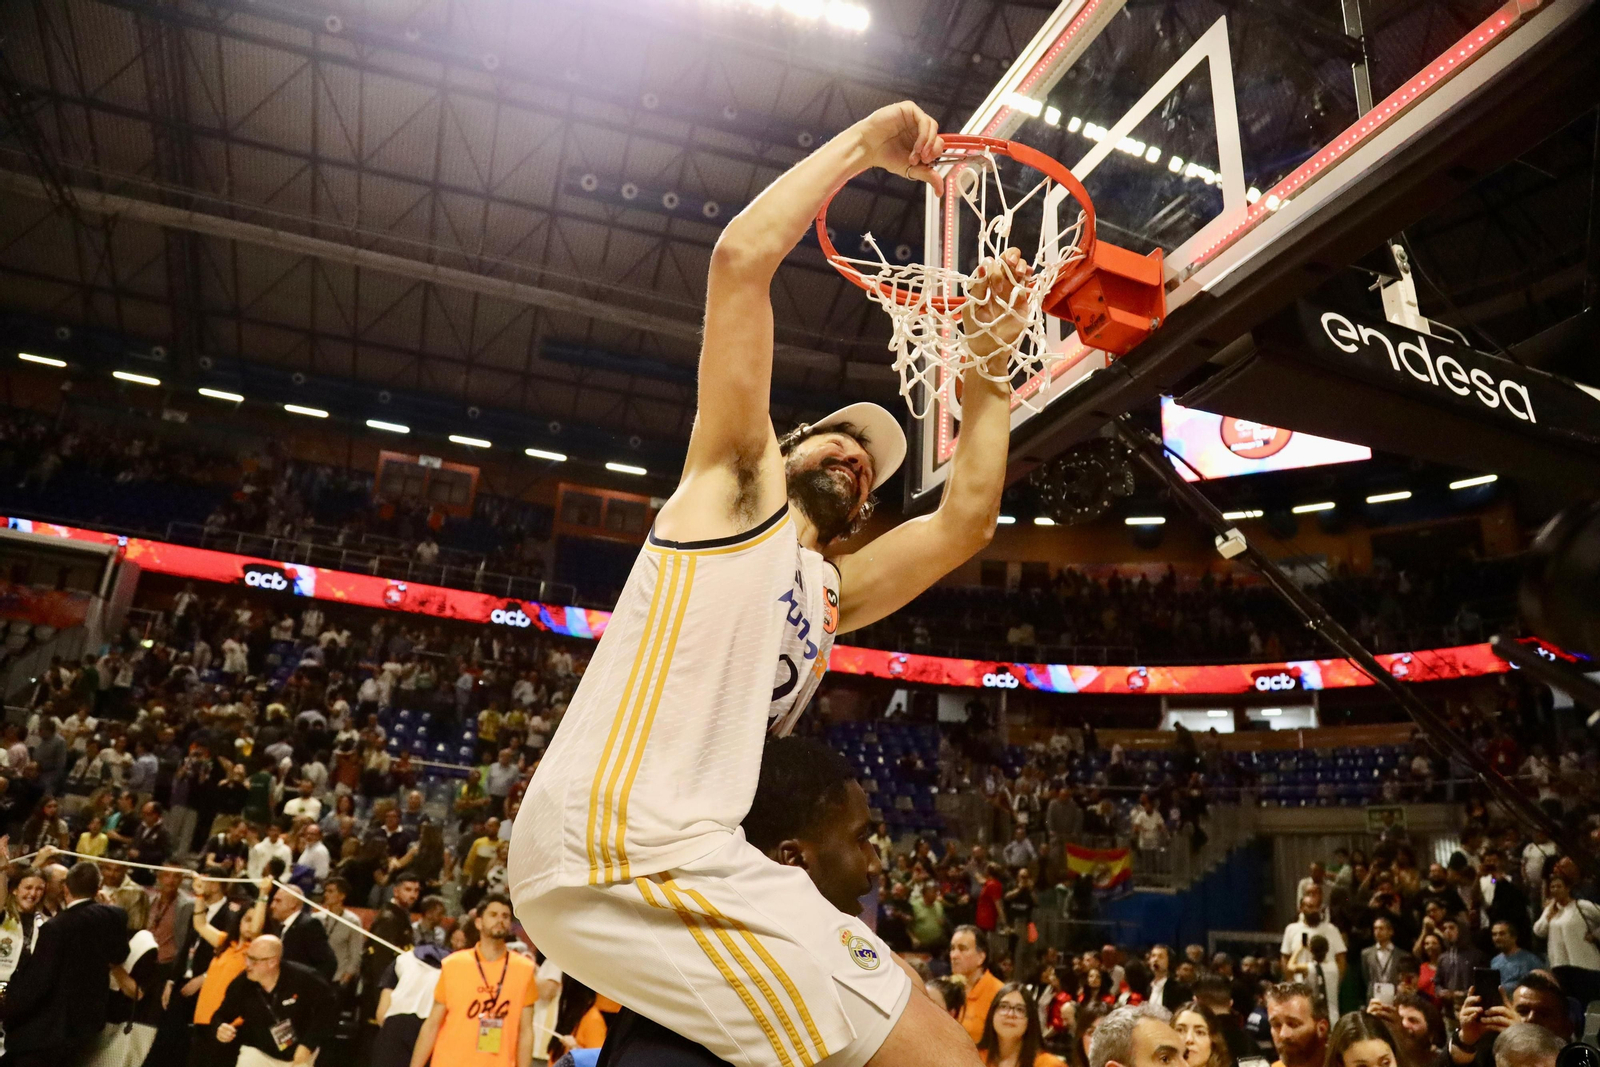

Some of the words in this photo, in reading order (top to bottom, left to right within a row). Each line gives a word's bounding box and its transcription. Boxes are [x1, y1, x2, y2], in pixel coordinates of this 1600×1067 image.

[1320, 311, 1537, 424] endesa
[244, 570, 288, 591] acb
[490, 608, 531, 628] acb
[982, 671, 1020, 689] acb
[1255, 672, 1296, 691] acb
[466, 998, 510, 1019] ORG
